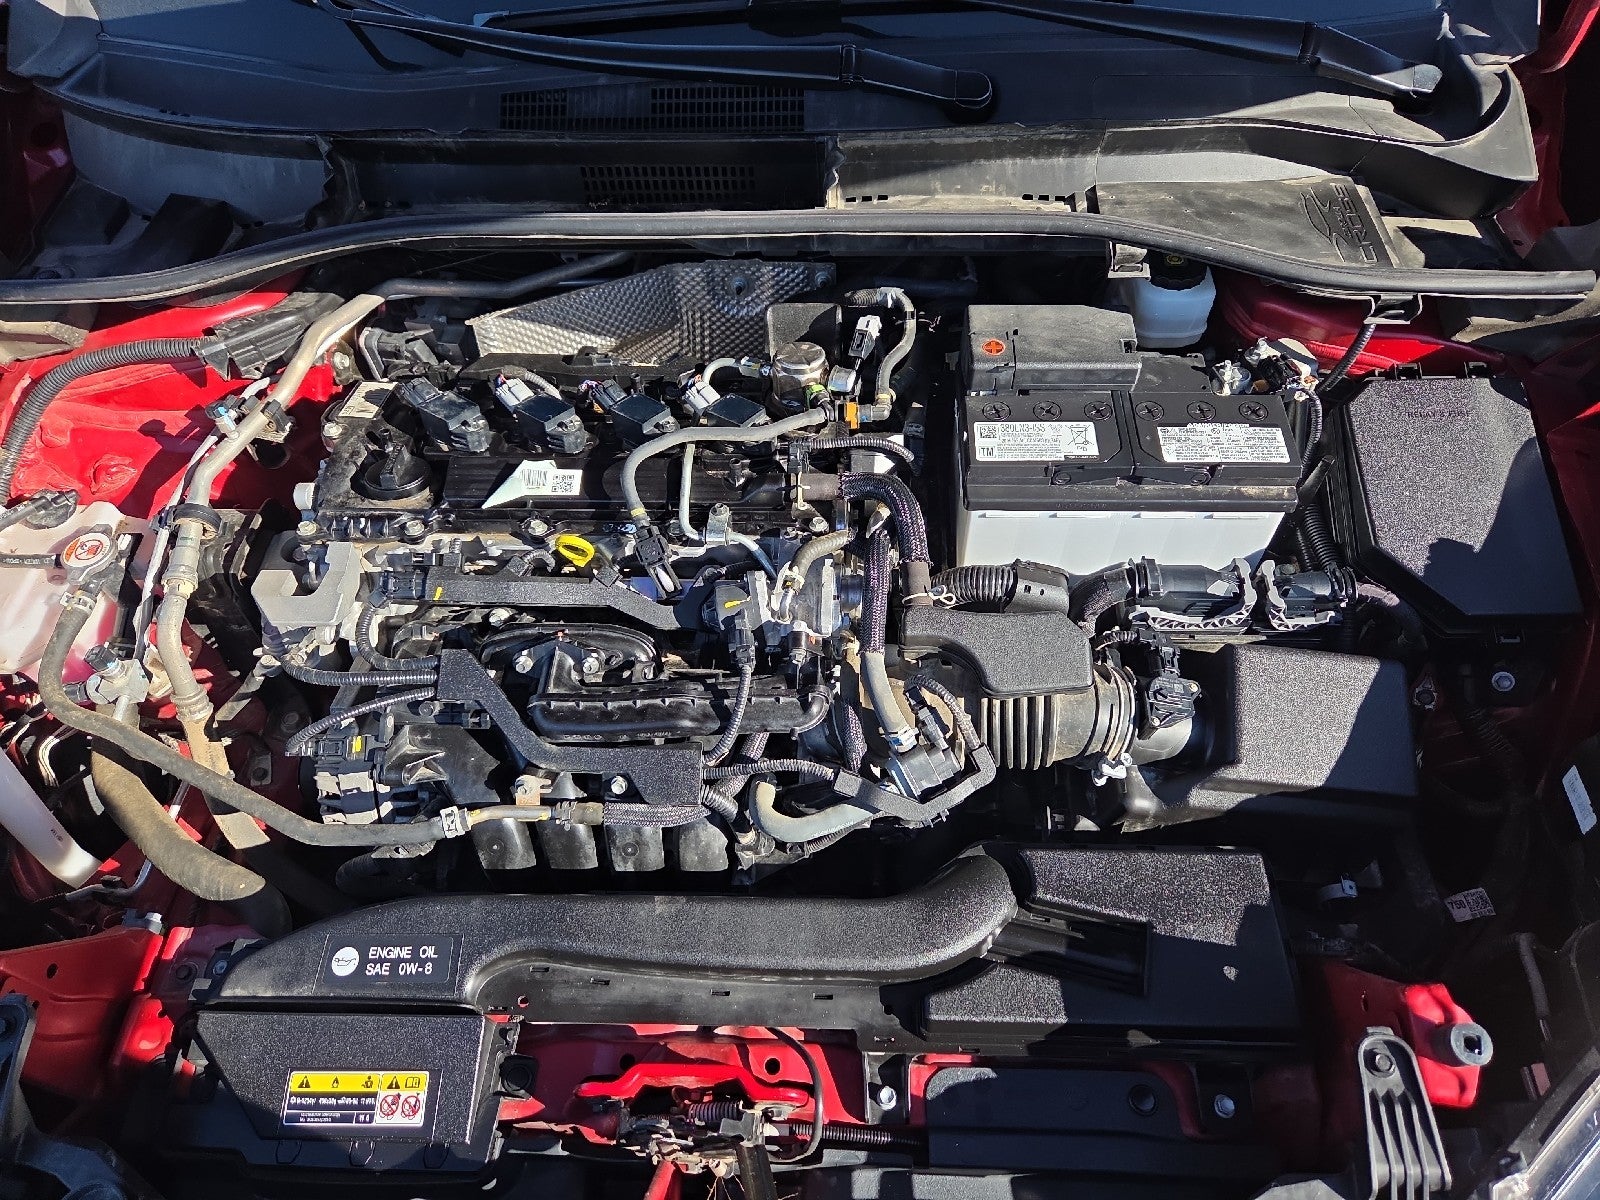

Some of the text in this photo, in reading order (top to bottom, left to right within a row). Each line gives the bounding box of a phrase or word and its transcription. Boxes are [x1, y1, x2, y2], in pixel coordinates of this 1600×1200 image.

[368, 945, 438, 959] ENGINE OIL
[365, 962, 433, 976] SAE 0W-8
